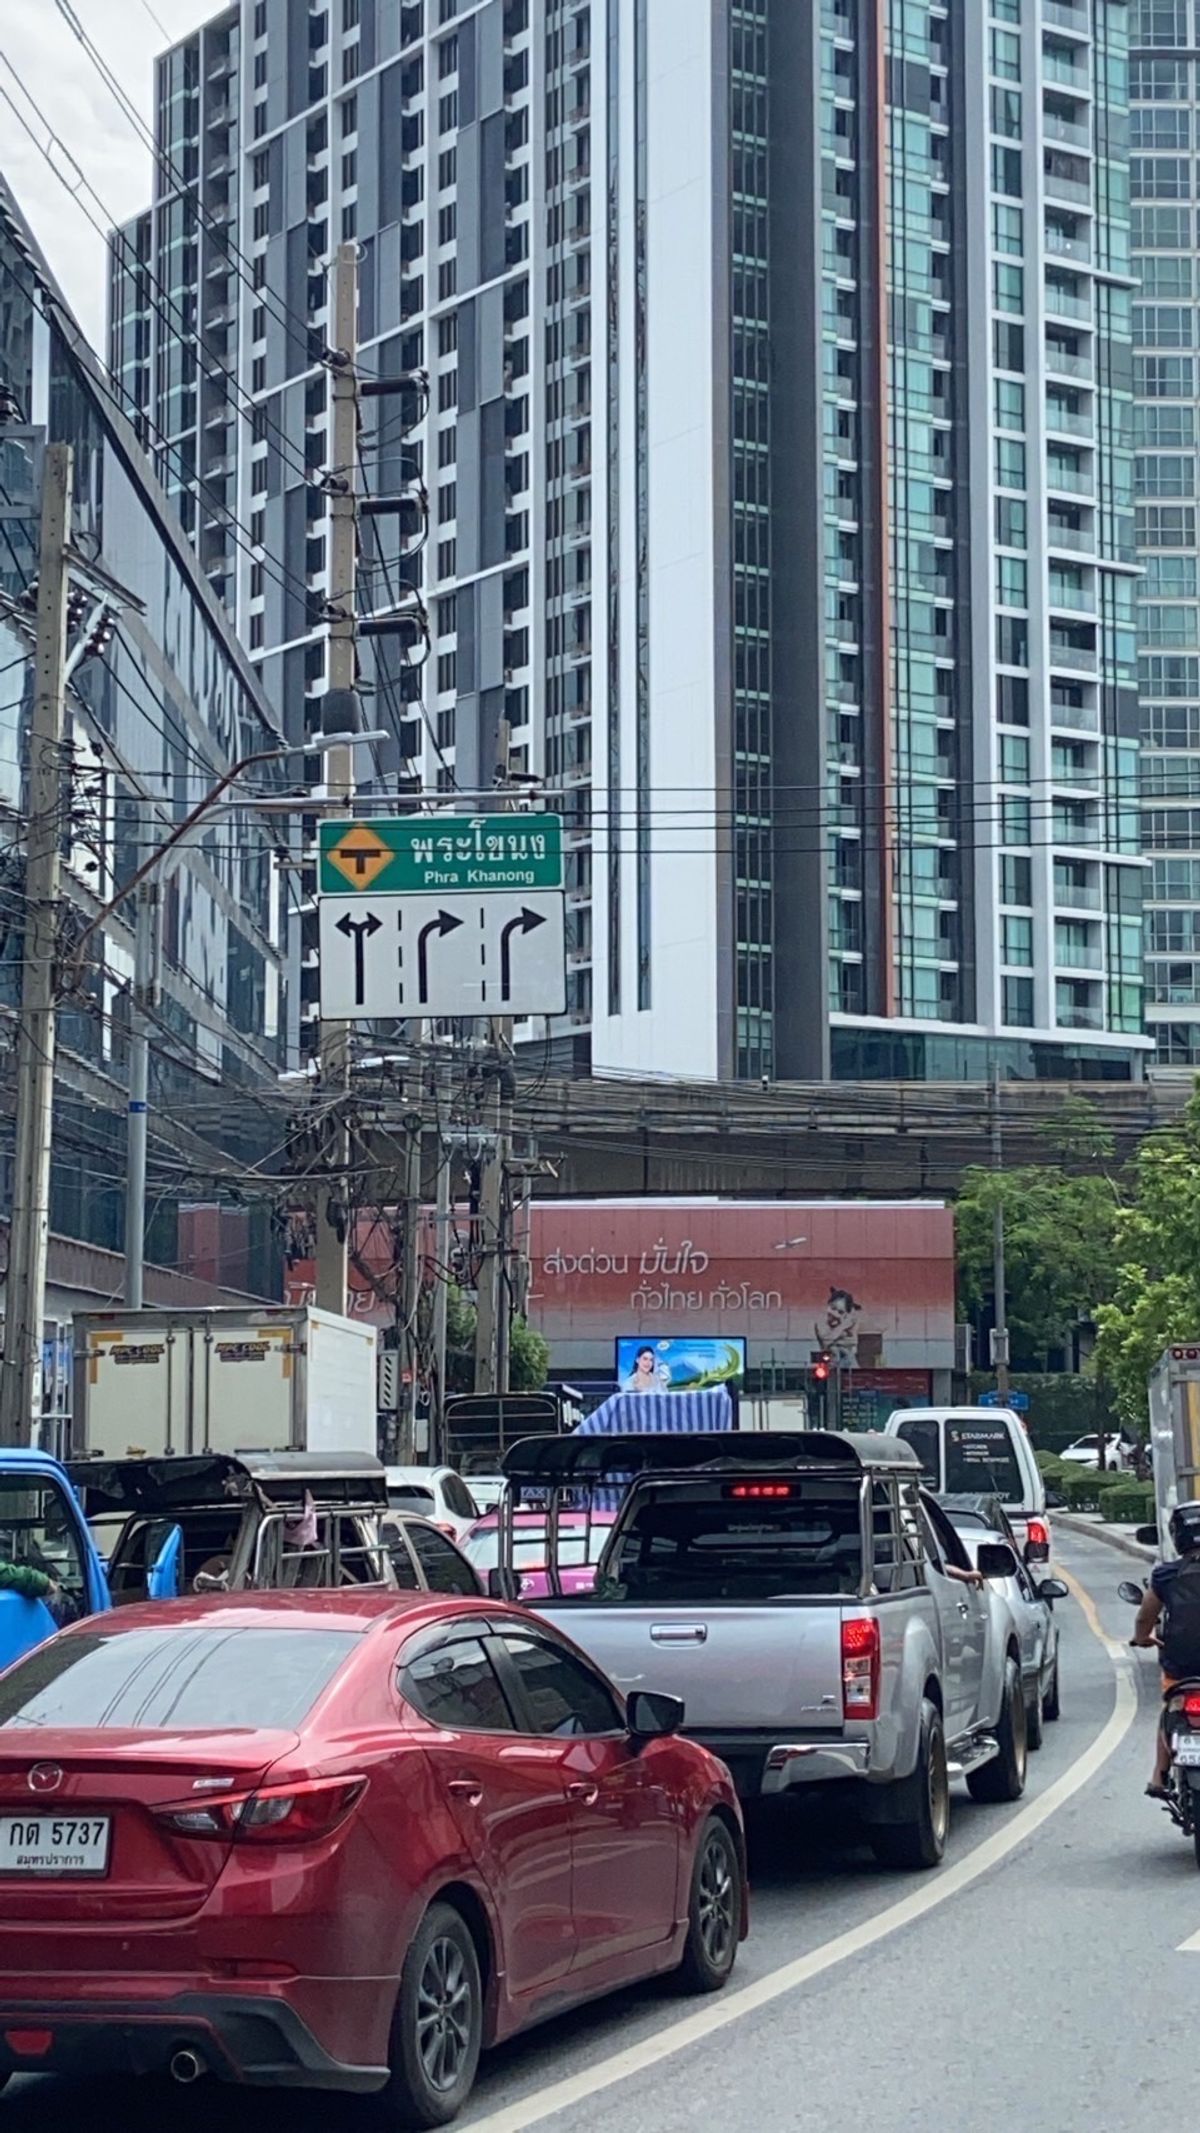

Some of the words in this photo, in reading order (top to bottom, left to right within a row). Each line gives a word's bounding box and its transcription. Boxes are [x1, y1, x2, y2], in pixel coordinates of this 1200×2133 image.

[410, 819, 546, 863] พระโขนง
[424, 870, 459, 883] Phra
[467, 869, 535, 884] Khanong
[543, 1247, 629, 1275] ส่งด่วน
[639, 1237, 709, 1275] มั่นใจ
[631, 1280, 704, 1311] ทั่วไทย
[709, 1280, 783, 1311] ทั่วโลก
[961, 1432, 1005, 1440] STARMARK
[52, 1822, 105, 1846] 5737
[16, 1853, 85, 1868] สมุทรปราการ
